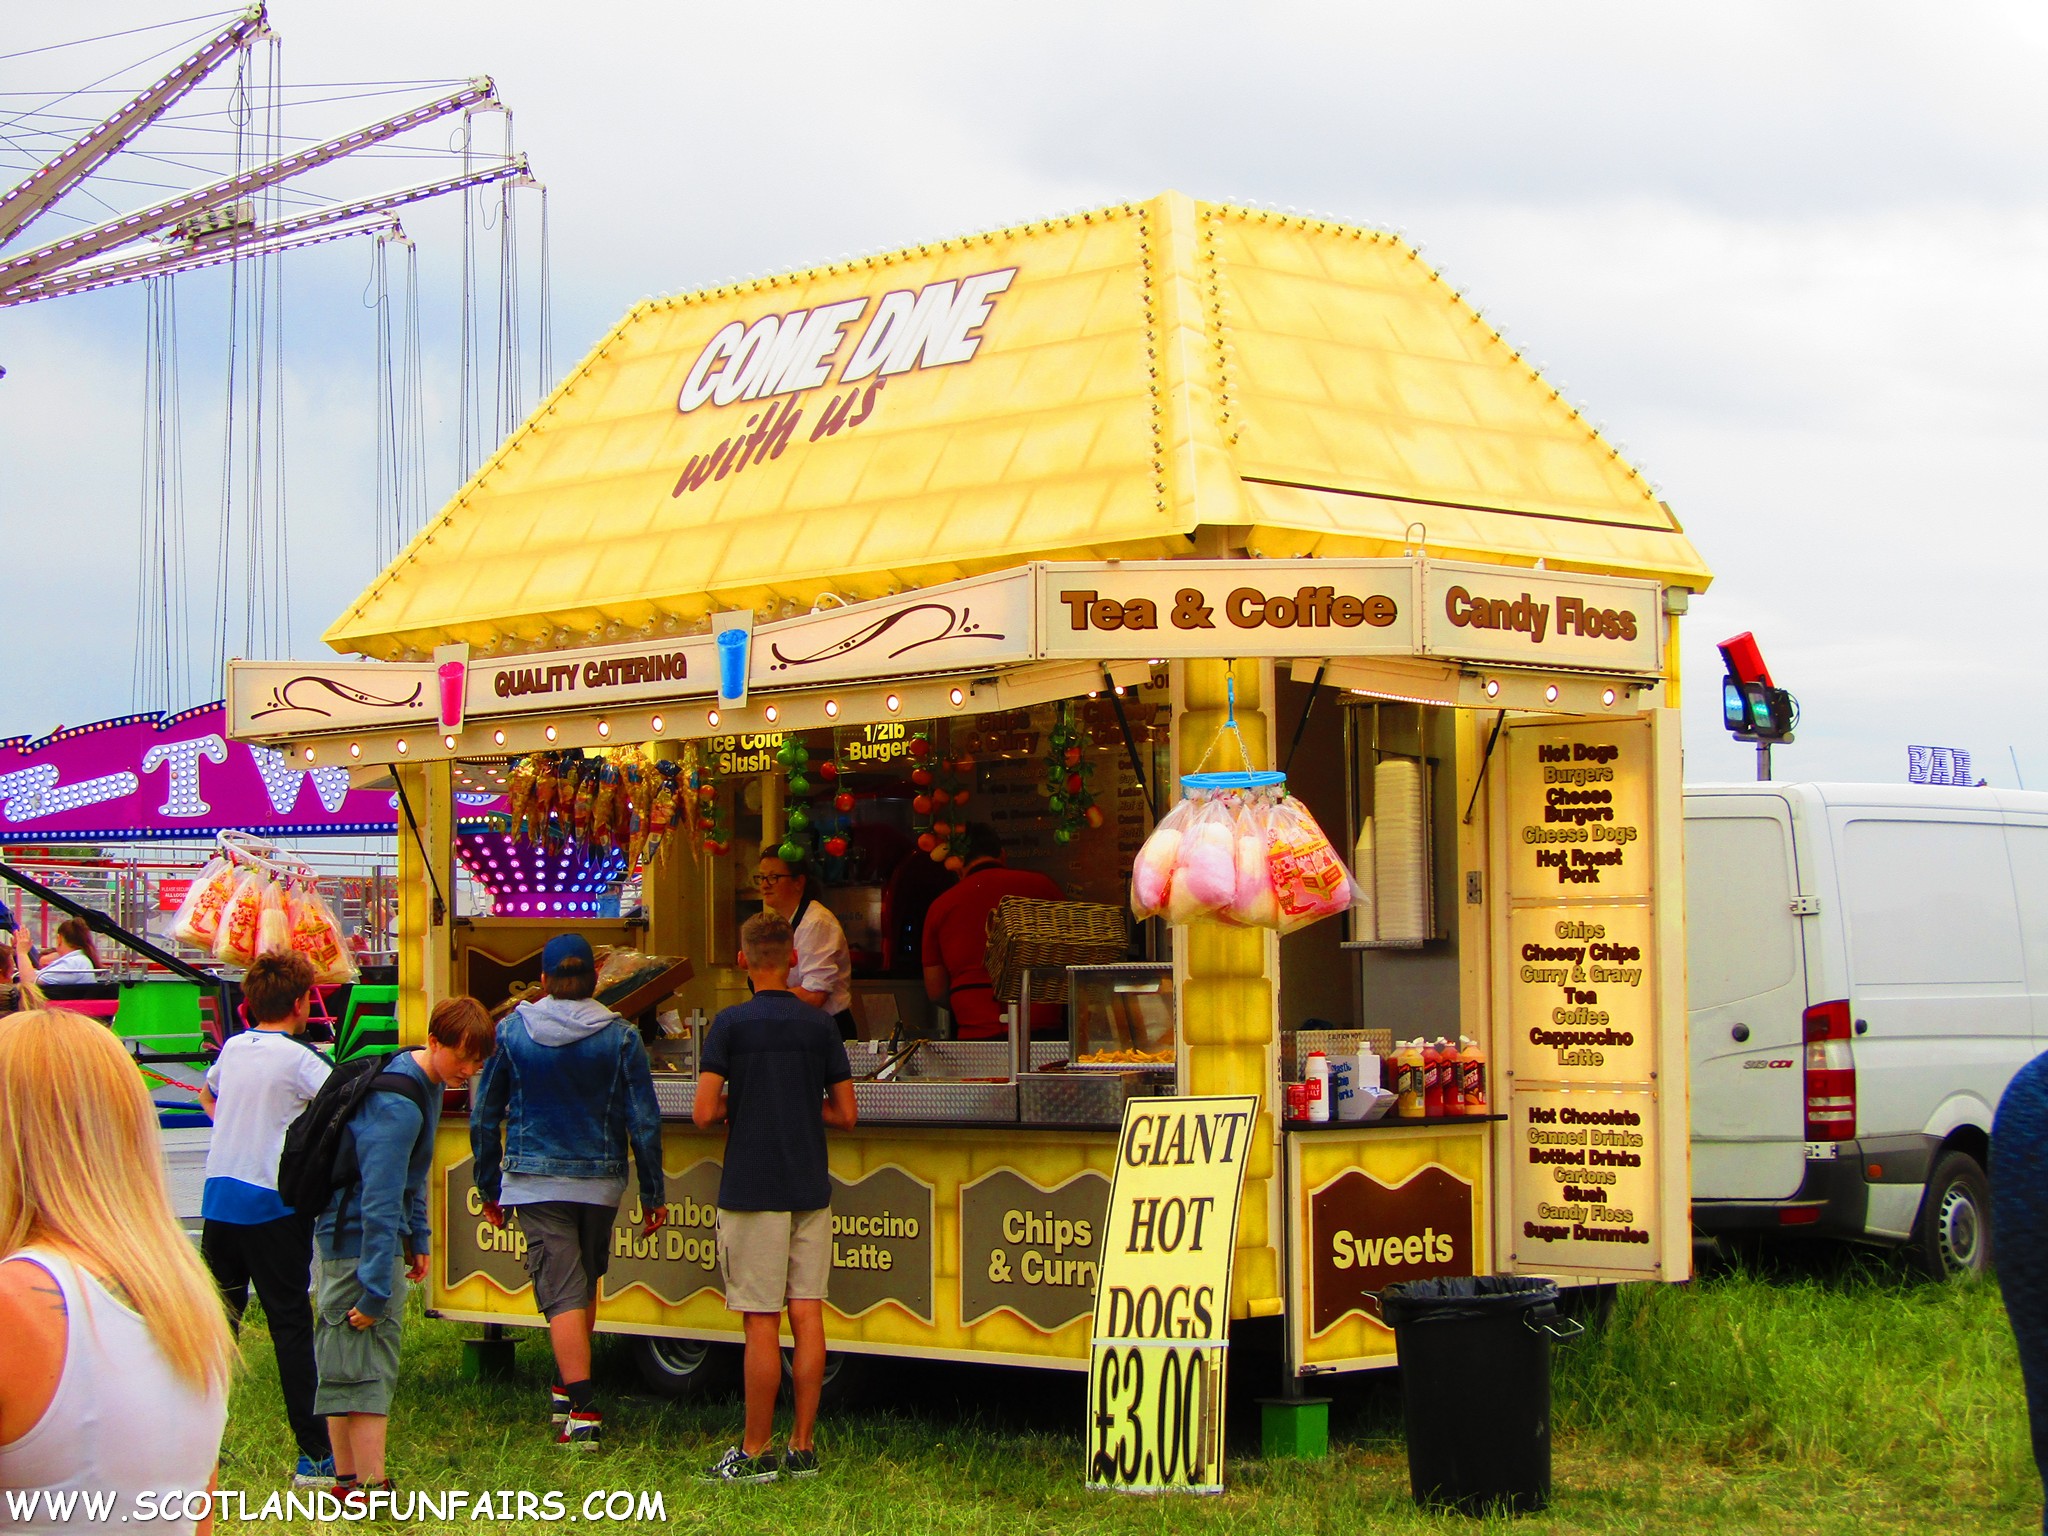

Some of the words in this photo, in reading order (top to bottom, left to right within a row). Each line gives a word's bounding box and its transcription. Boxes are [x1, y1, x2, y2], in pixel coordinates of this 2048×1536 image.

[677, 297, 869, 414] COME
[839, 266, 1021, 384] DINE
[671, 390, 804, 499] with
[808, 377, 887, 443] us
[1060, 589, 1159, 631] Tea
[1170, 587, 1216, 629] &
[1225, 585, 1398, 628] Coffee
[1445, 584, 1549, 643] Candy
[1556, 595, 1638, 641] Floss
[494, 662, 580, 698] QUALITY
[582, 652, 688, 688] CATERING
[719, 750, 771, 775] Slush
[850, 740, 914, 763] Burger
[1538, 744, 1570, 763] Hot
[1573, 743, 1619, 764] Dogs
[1544, 766, 1614, 786] Burgers
[1546, 788, 1612, 805] Cheese
[1544, 805, 1614, 826] Burgers
[1522, 825, 1588, 844] Cheese
[1592, 824, 1637, 845] Dogs
[1536, 849, 1567, 867] Hot
[1571, 848, 1623, 867] Roast
[1558, 866, 1600, 884] Pork
[1554, 921, 1606, 942] Chips
[1521, 943, 1586, 966] Cheesy
[1589, 942, 1641, 965] Chips
[1520, 964, 1568, 986] Curry
[1571, 964, 1586, 983] &
[1589, 964, 1642, 986] Gravy
[1564, 987, 1598, 1005] Tea
[1552, 1006, 1610, 1025] Coffee
[1529, 1027, 1634, 1049] Cappuccino
[1557, 1048, 1604, 1066] Latte
[1528, 1107, 1557, 1124] Hot
[1559, 1107, 1641, 1126] Chocolate
[1124, 1111, 1248, 1168] GIANT
[1527, 1127, 1587, 1146] Canned
[1591, 1129, 1643, 1147] Drinks
[1529, 1147, 1585, 1165] Bottled
[1588, 1149, 1641, 1167] Drinks
[1553, 1166, 1617, 1185] Cartons
[1563, 1185, 1607, 1203] Slush
[628, 1194, 718, 1230] Jmbo
[1538, 1202, 1588, 1224] Candy
[1591, 1204, 1634, 1223] Floss
[1002, 1208, 1094, 1255] Chips
[1125, 1195, 1215, 1255] HOT
[1523, 1221, 1570, 1243] Sugar
[1573, 1223, 1649, 1244] Dummies
[476, 1220, 528, 1262] Chip
[614, 1226, 660, 1260] Hot
[666, 1229, 720, 1271] Dog
[1332, 1227, 1454, 1270] Sweets
[832, 1241, 893, 1271] Latte
[987, 1248, 1014, 1284] &
[1107, 1284, 1215, 1340] DOGS
[1092, 1344, 1206, 1487] £3.00
